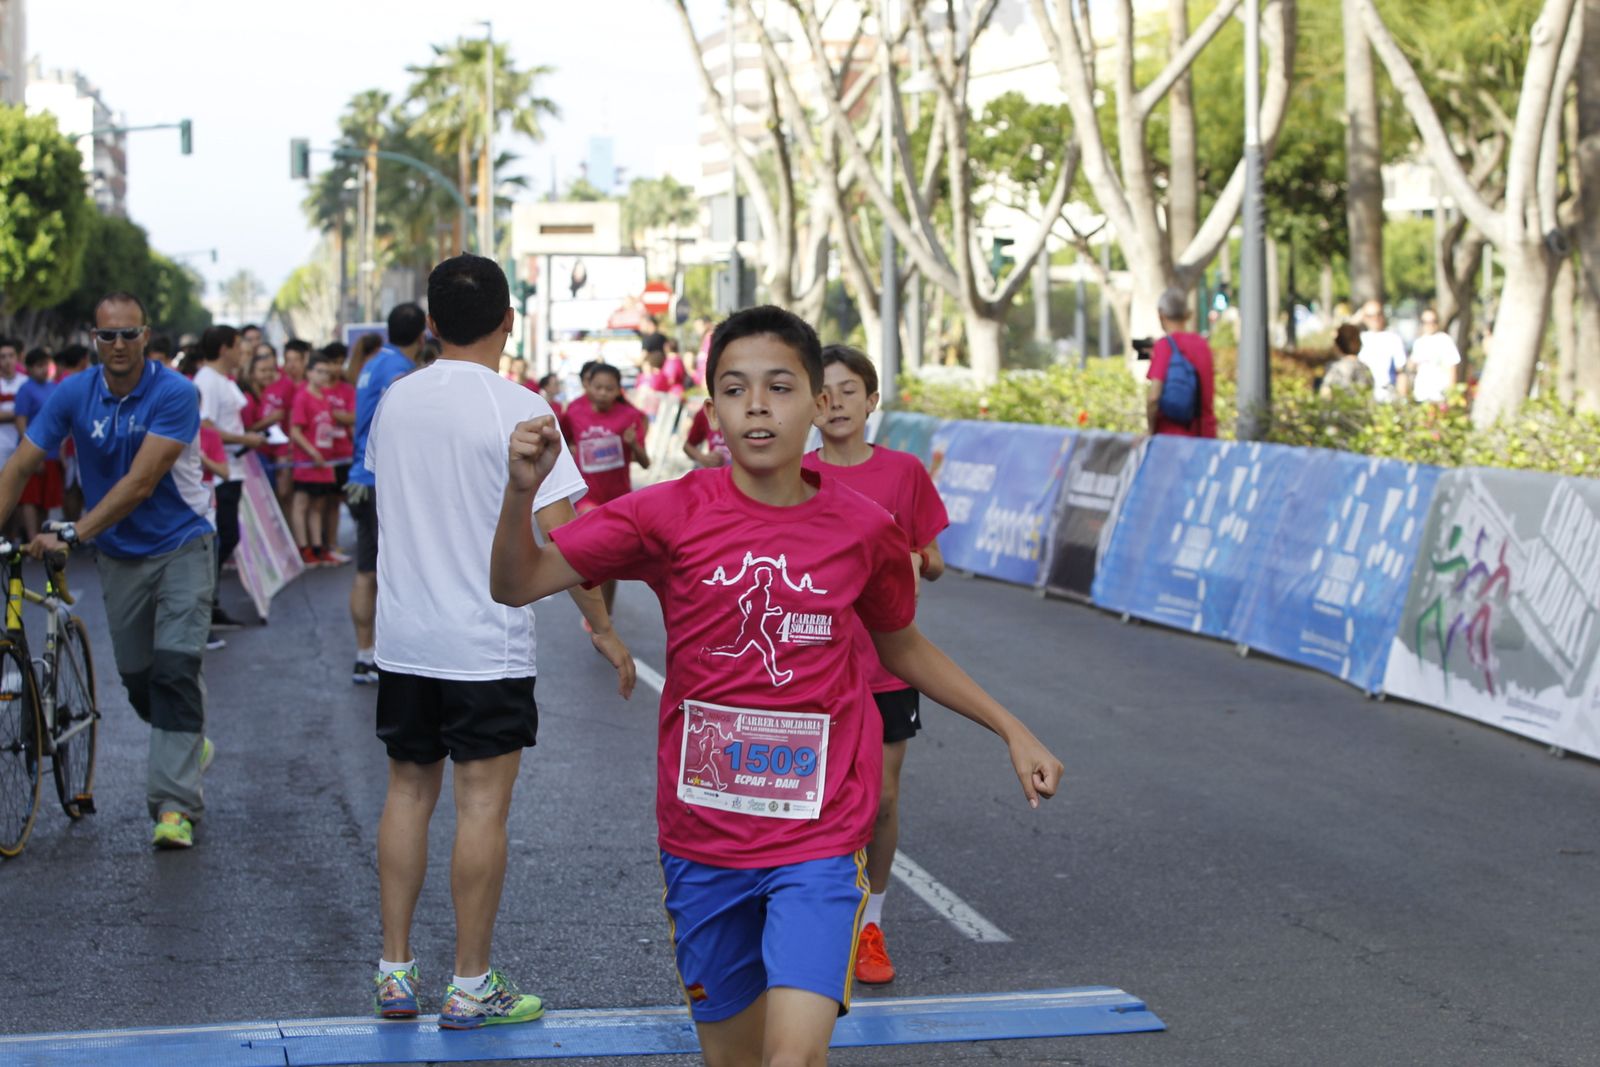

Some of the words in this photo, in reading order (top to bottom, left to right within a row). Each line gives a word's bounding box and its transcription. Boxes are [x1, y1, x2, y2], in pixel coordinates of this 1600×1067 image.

[776, 612, 792, 643] 4
[791, 612, 833, 626] CARRERA
[790, 623, 832, 636] SOLIDARIA
[742, 714, 779, 728] CARRERA
[780, 718, 820, 730] SOLIDARIA
[724, 741, 817, 777] 1509
[774, 778, 800, 789] DANI
